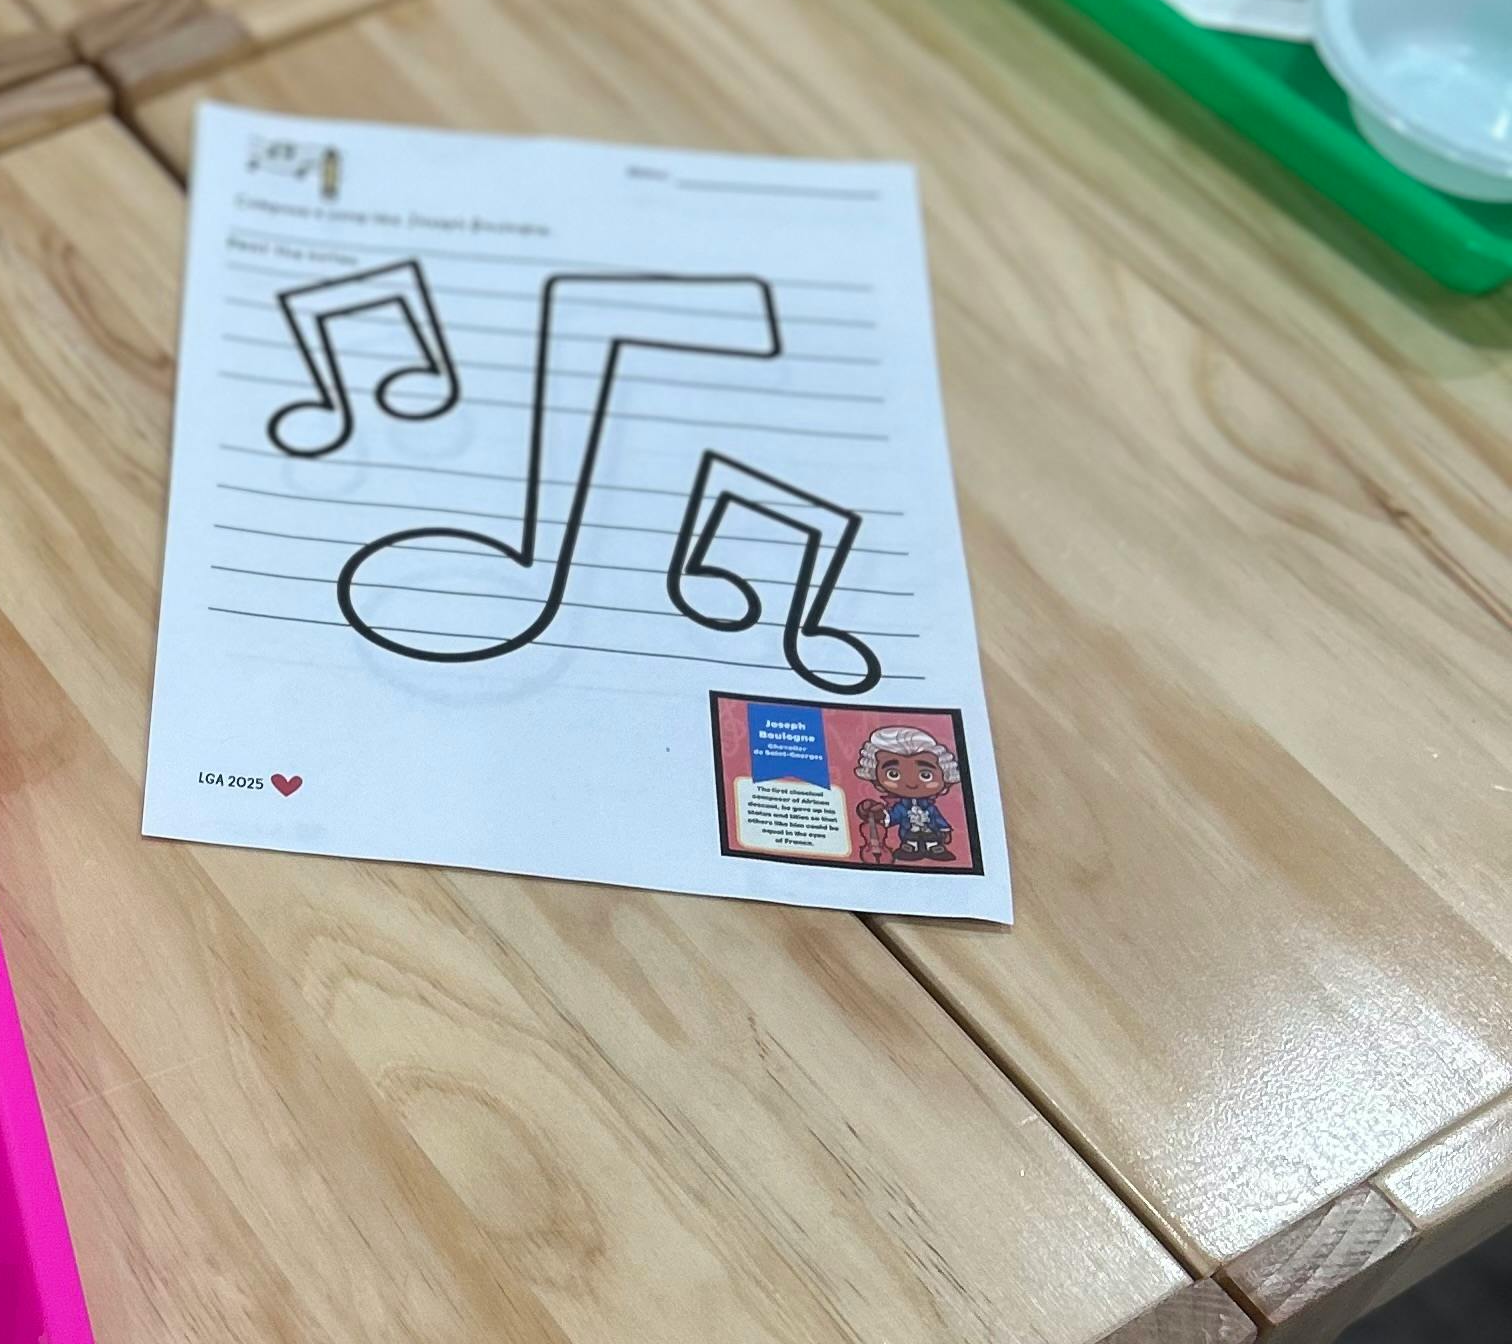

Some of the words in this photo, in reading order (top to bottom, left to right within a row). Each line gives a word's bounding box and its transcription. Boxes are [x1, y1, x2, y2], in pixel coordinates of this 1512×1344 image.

[765, 719, 807, 731] Joseph
[758, 730, 816, 743] Boulogne
[198, 771, 224, 787] LGA
[227, 775, 264, 790] 2025
[756, 785, 771, 793] The
[771, 787, 788, 795] first
[751, 794, 791, 803] composer
[801, 798, 830, 806] African
[823, 807, 836, 815] his
[747, 817, 773, 826] others
[789, 821, 805, 829] him
[805, 823, 828, 831] could
[828, 824, 840, 832] be
[761, 828, 785, 836] equal
